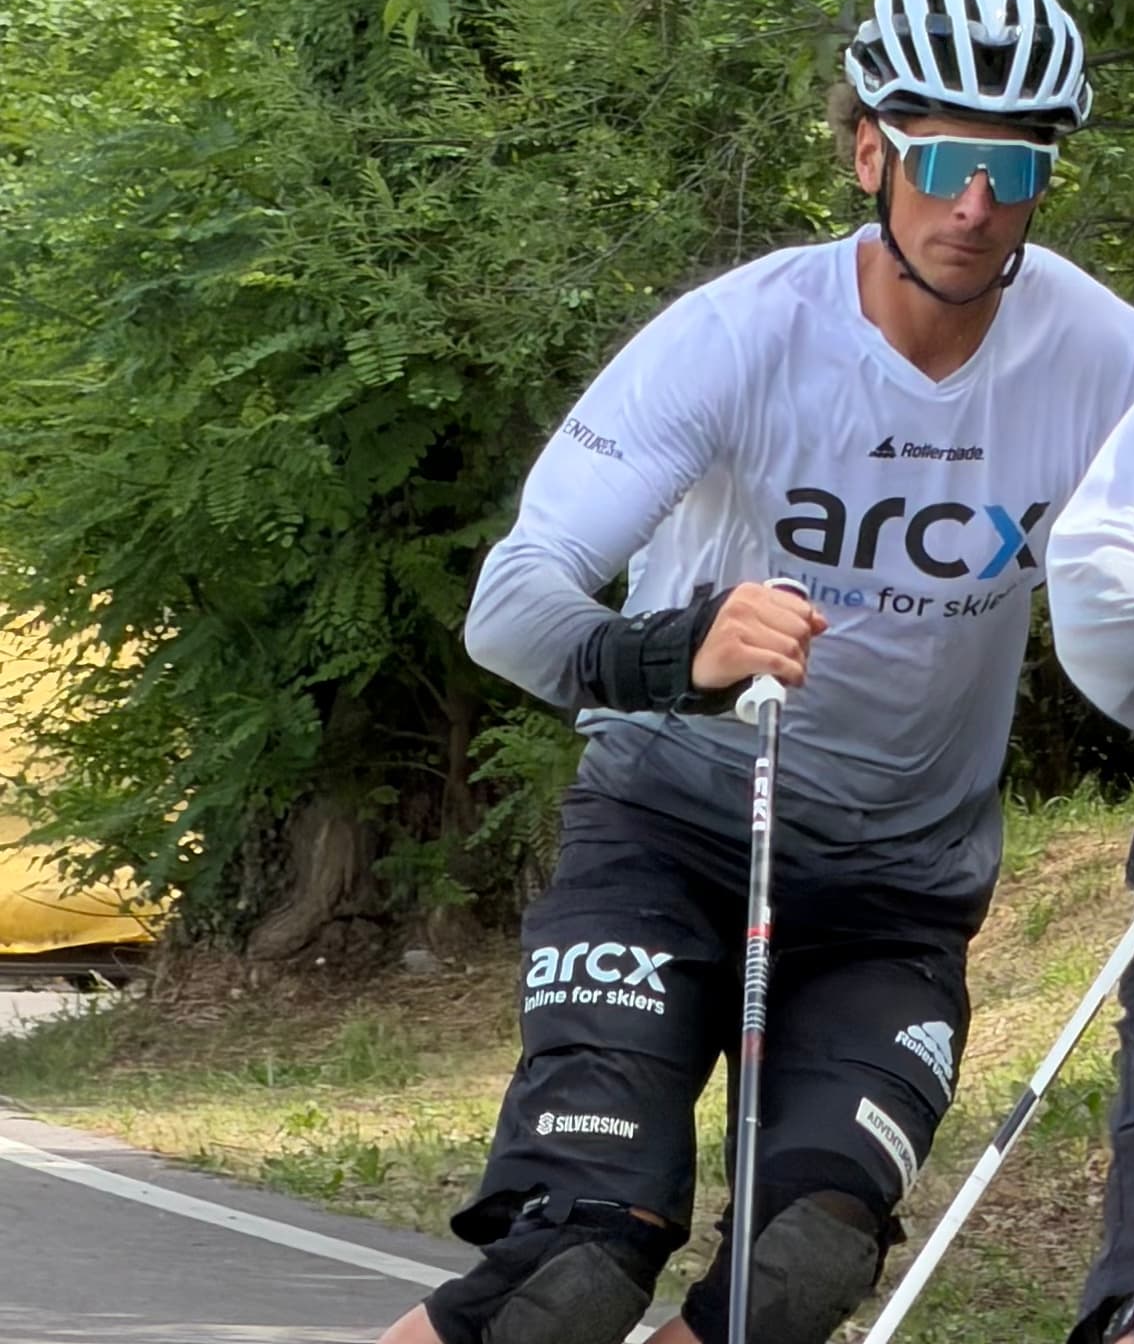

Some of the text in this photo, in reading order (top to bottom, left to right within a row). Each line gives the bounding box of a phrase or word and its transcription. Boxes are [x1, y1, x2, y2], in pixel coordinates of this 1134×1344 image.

[774, 487, 1051, 580] arcx
[877, 586, 935, 617] for
[526, 942, 674, 994] arcx
[524, 986, 665, 1016] inline for skiers
[555, 1114, 634, 1139] SILVERSKIN
